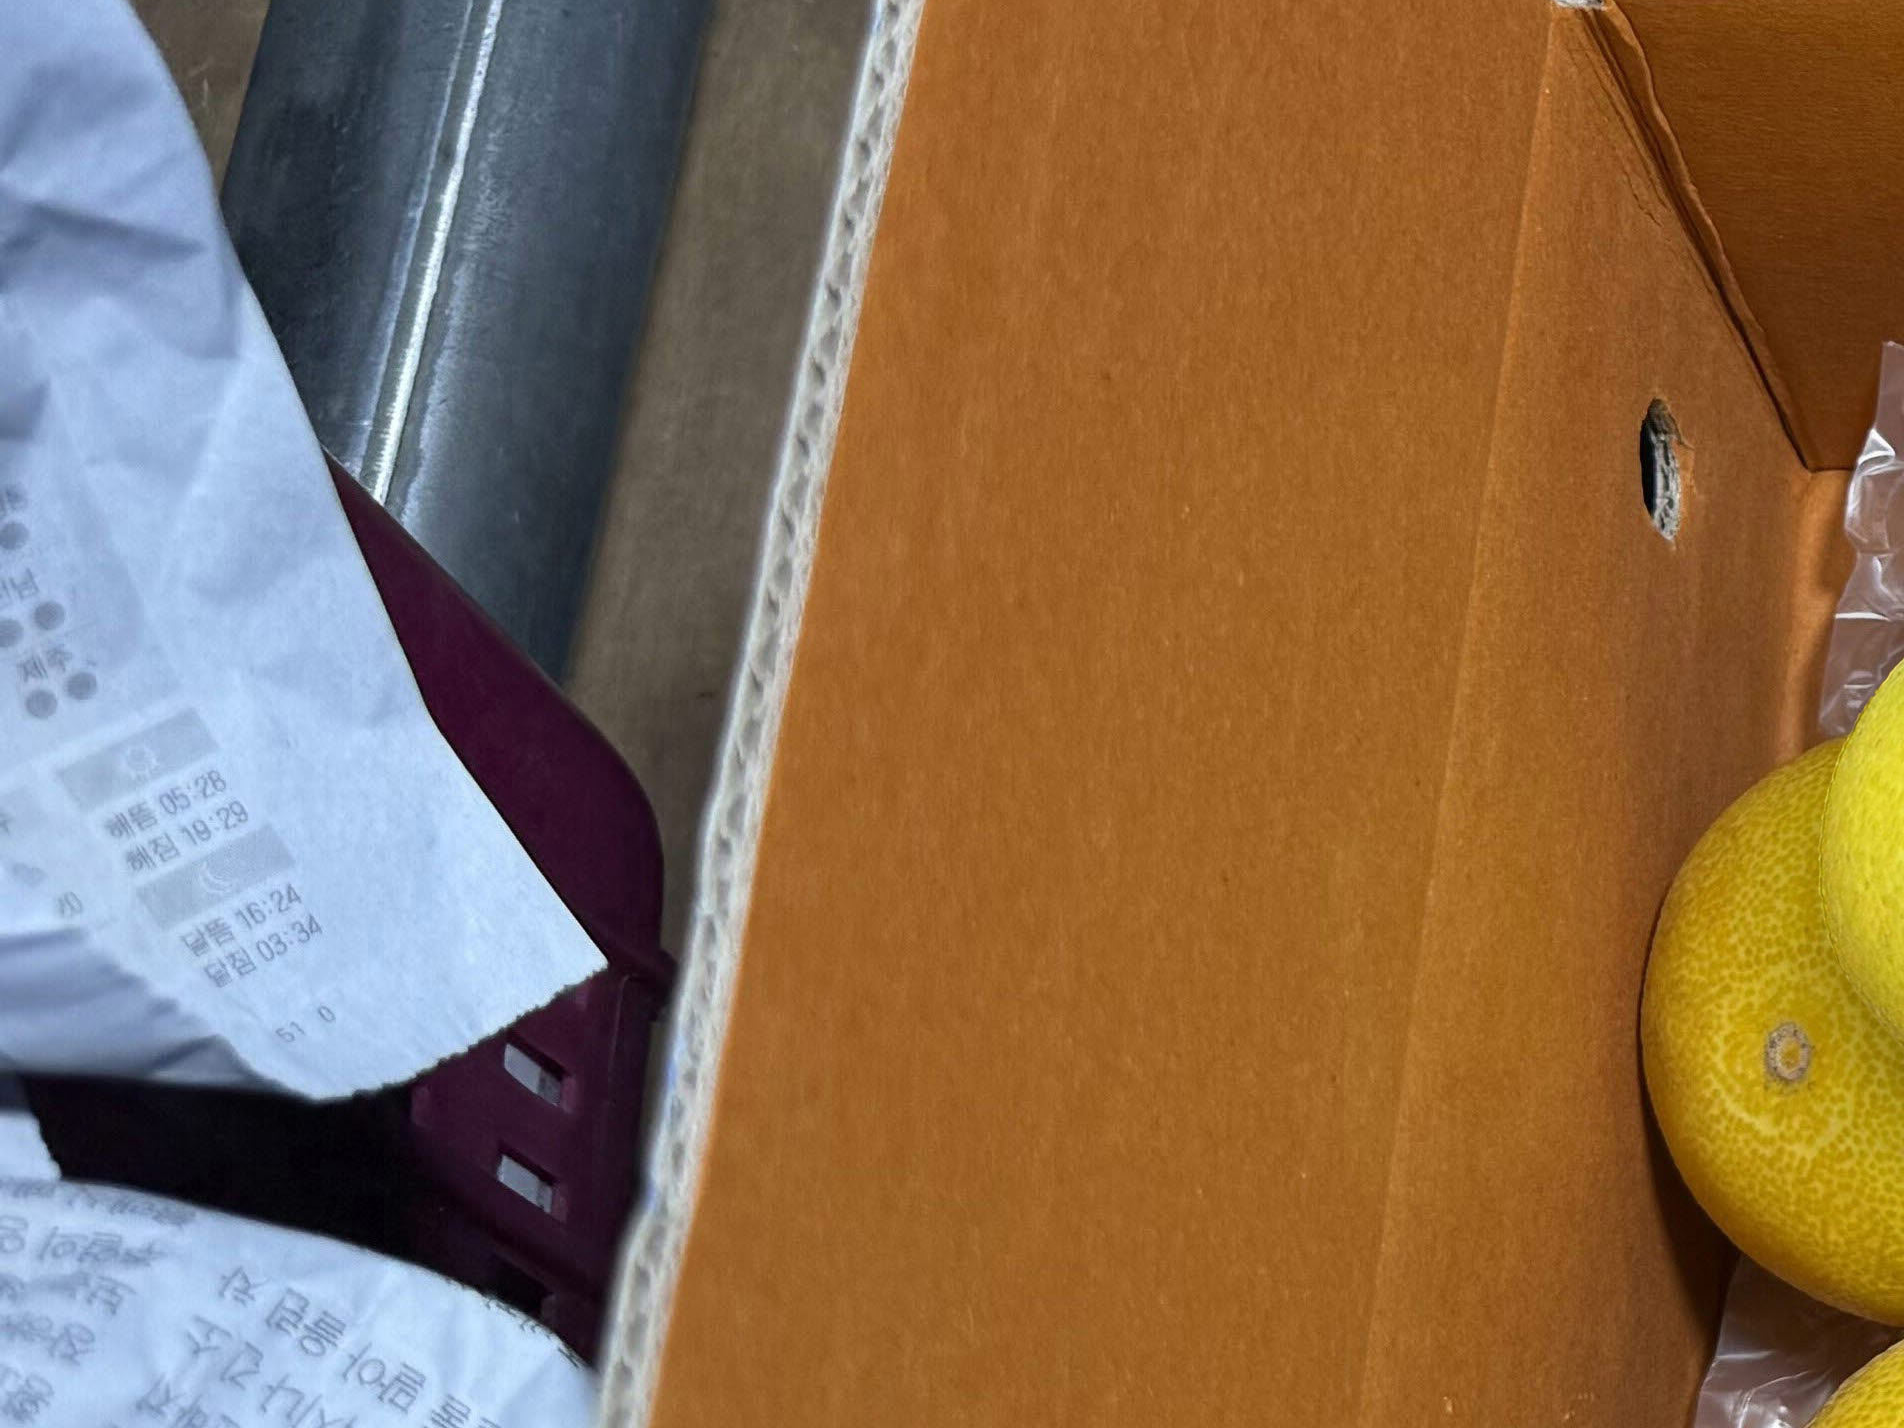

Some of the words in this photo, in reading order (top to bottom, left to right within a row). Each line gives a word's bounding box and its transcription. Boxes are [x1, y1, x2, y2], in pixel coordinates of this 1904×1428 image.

[234, 882, 302, 929] 16:24
[255, 913, 322, 962] 03:34
[216, 1265, 261, 1306] 차
[216, 1340, 263, 1390] 긴
[339, 1342, 425, 1413] 말아
